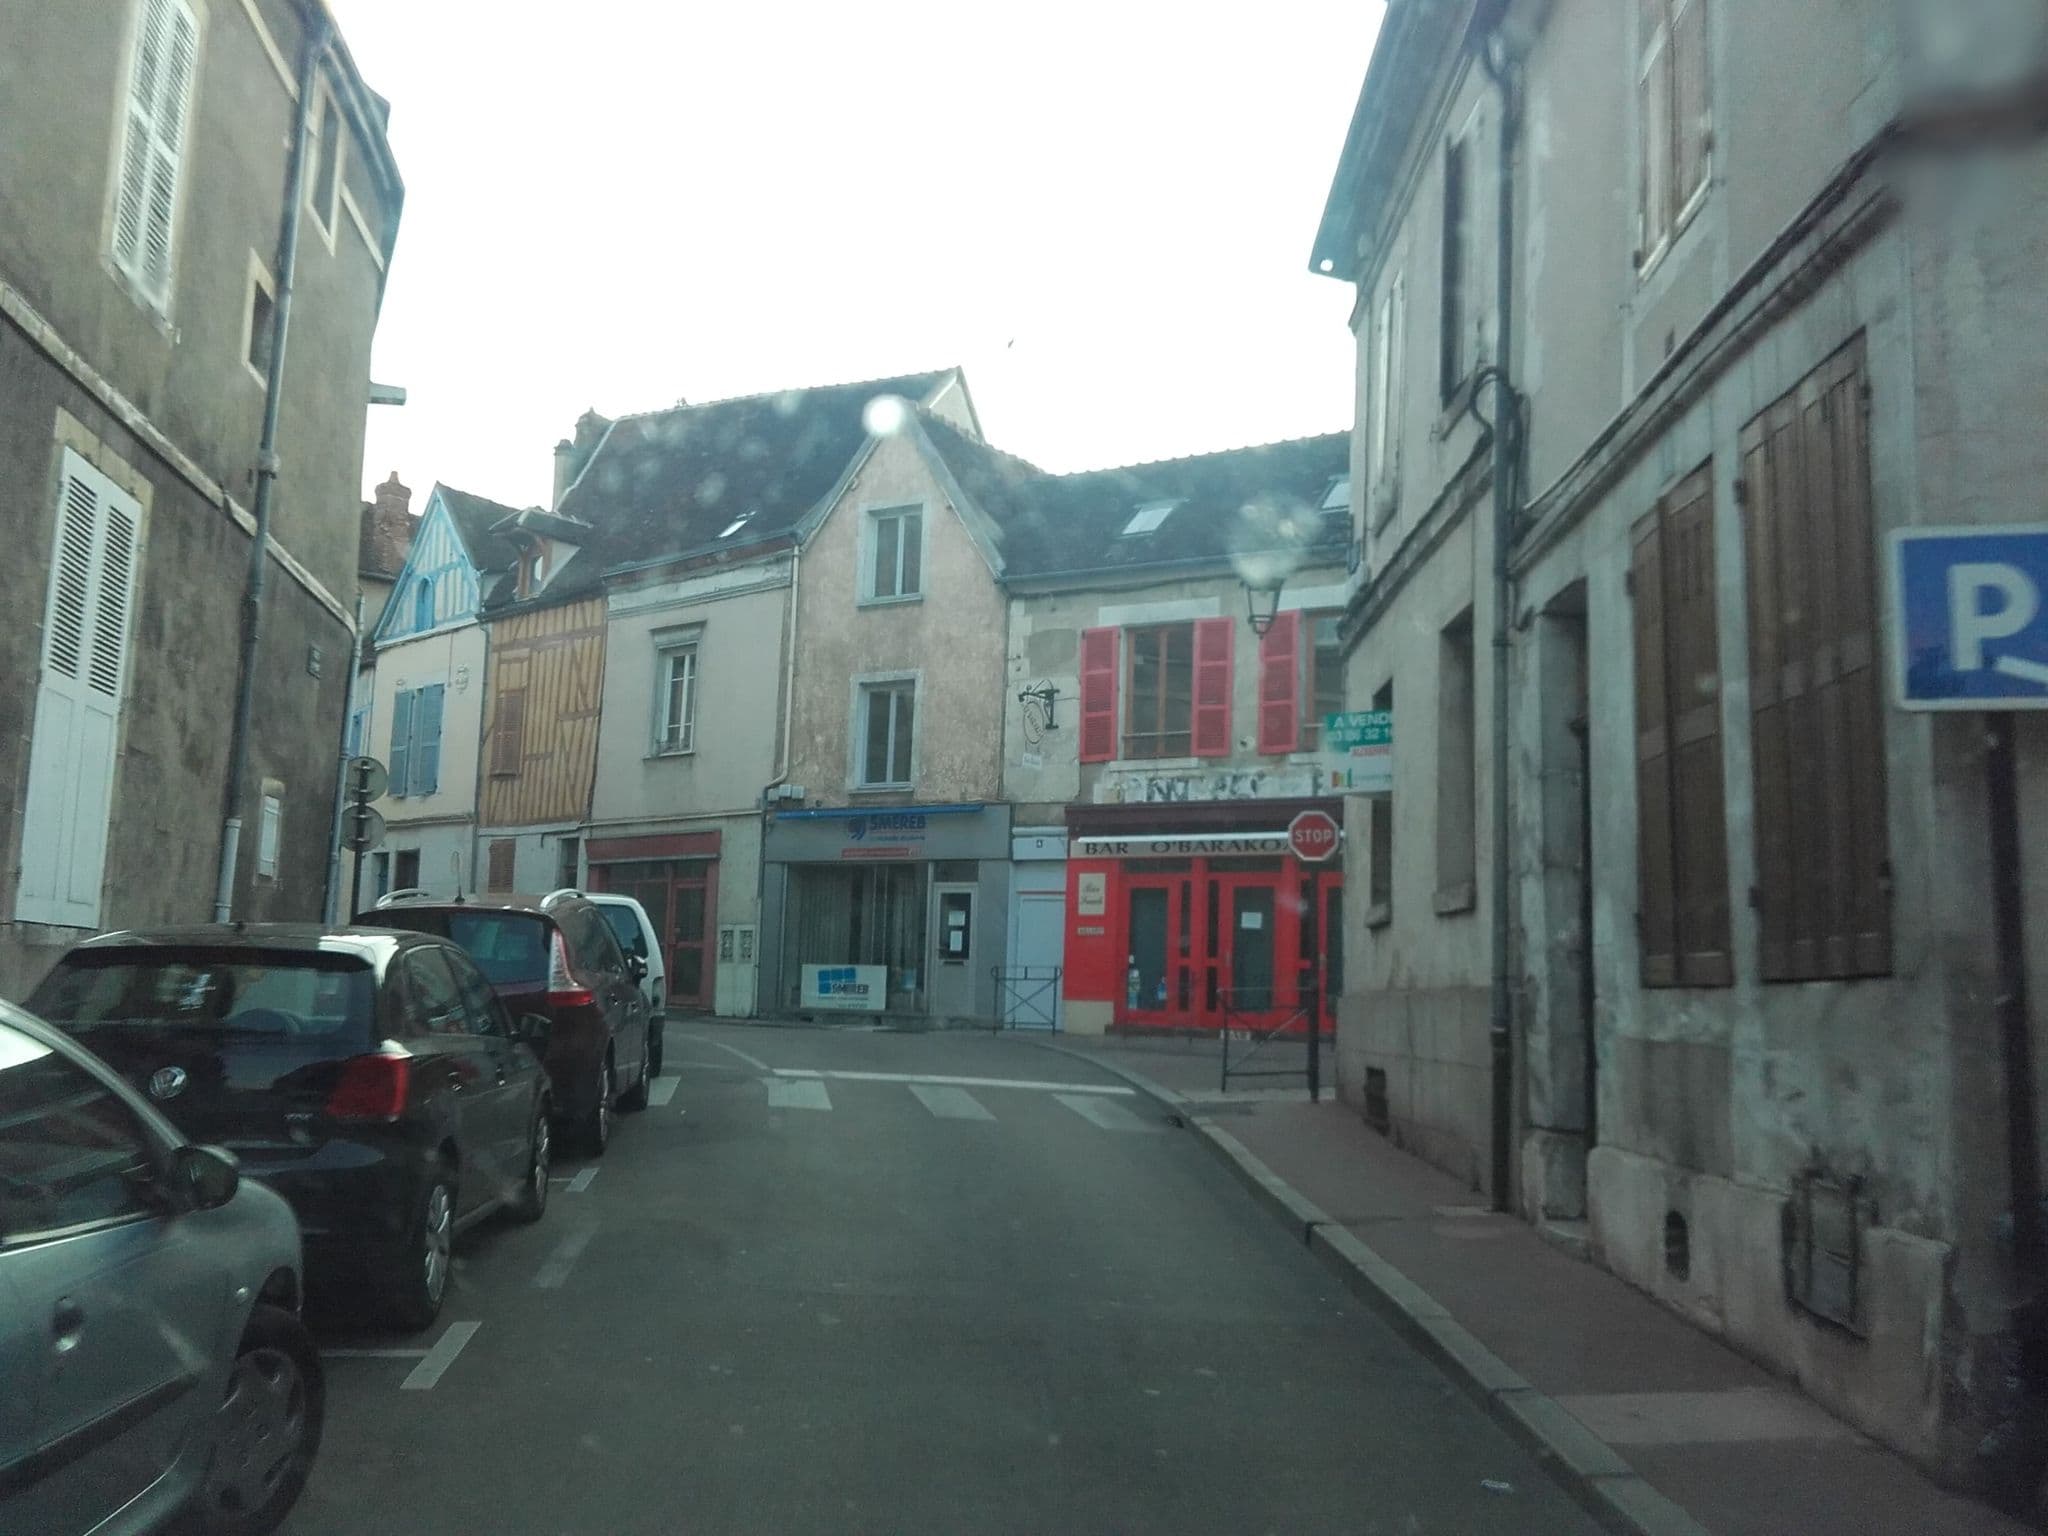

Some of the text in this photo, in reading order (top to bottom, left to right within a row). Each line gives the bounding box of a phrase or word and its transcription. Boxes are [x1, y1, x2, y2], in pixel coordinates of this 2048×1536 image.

[1948, 563, 2040, 671] P
[1348, 713, 1392, 727] VEND
[1364, 727, 1379, 740] 32
[1295, 830, 1332, 842] STOP
[1085, 842, 1128, 854] BAR
